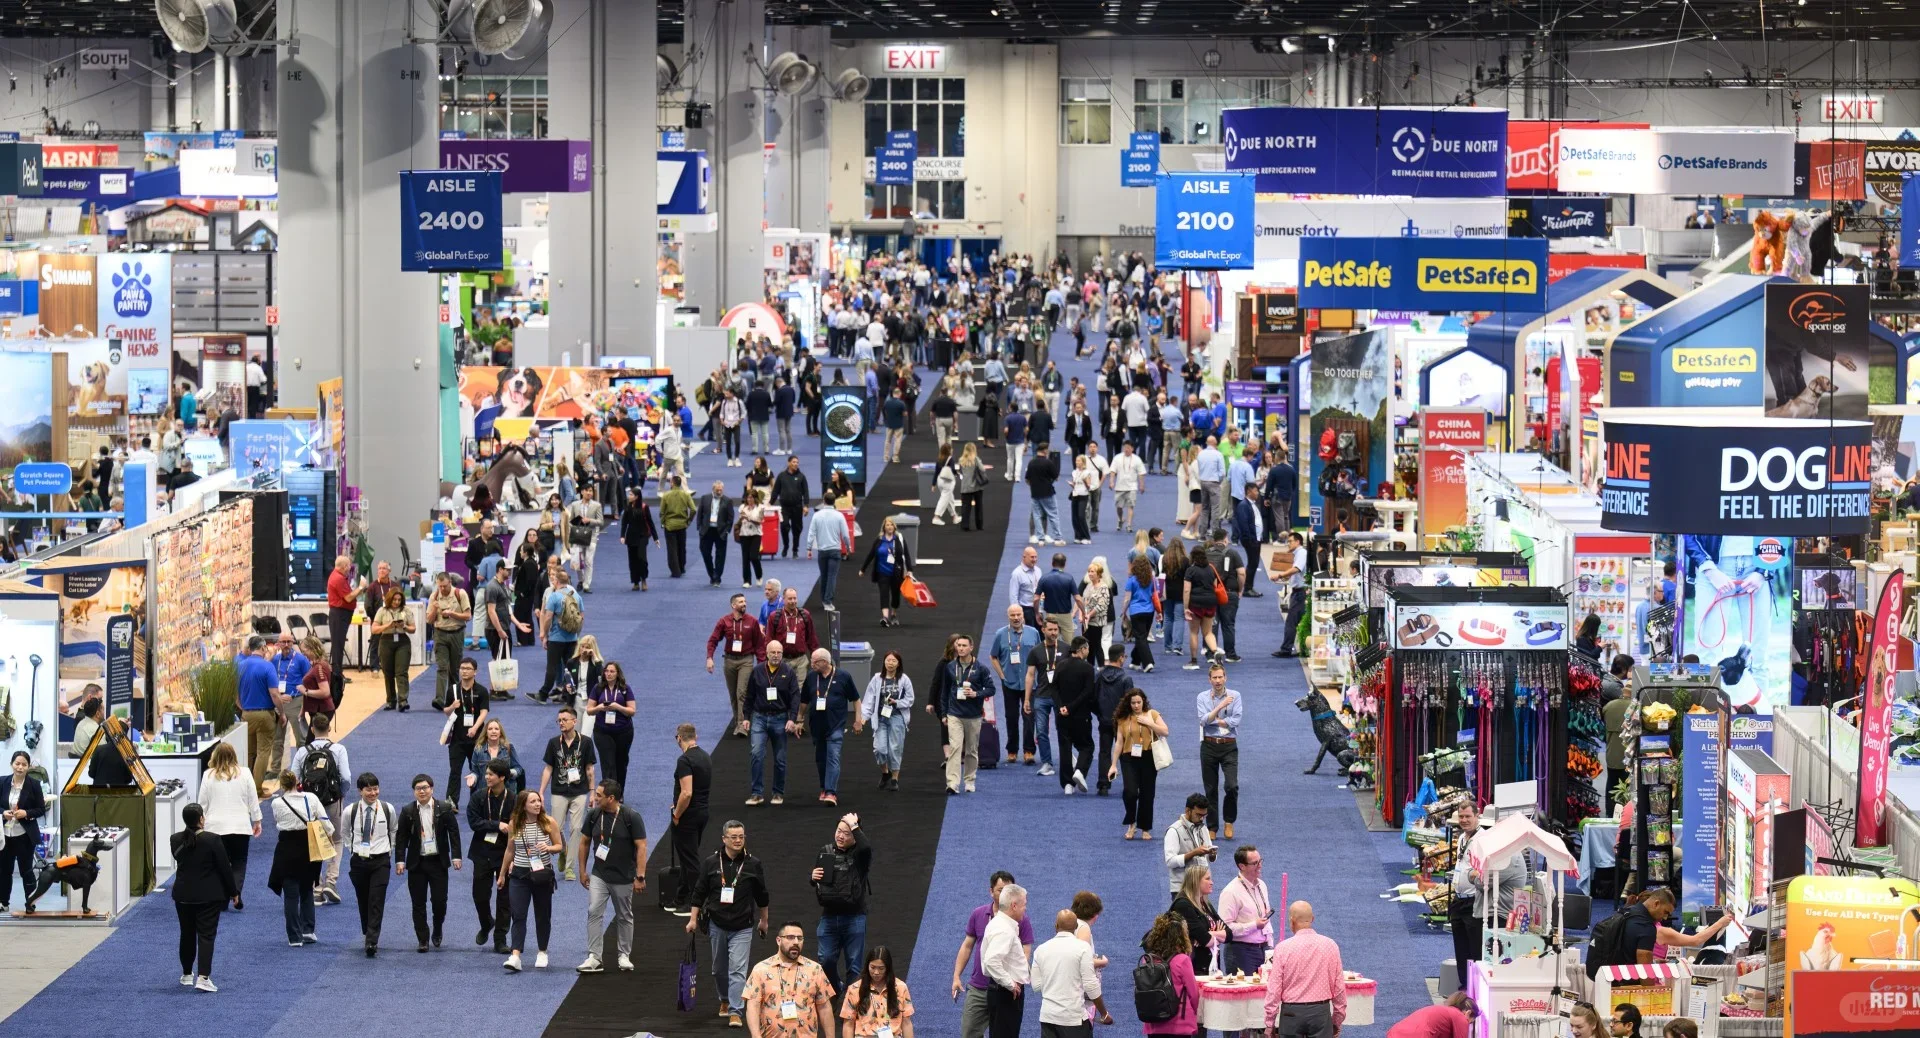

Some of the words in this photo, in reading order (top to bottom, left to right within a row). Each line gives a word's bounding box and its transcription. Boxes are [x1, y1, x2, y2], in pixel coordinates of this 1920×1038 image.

[82, 54, 128, 65] SOUTH
[888, 50, 940, 69] EXIT
[1826, 100, 1878, 119] EXIT
[1241, 137, 1261, 150] DUE
[1265, 136, 1317, 149] NORTH
[1432, 140, 1460, 152] DUE
[1464, 140, 1498, 152] NORTH
[882, 162, 908, 171] 2400
[1128, 164, 1152, 172] 2100
[1816, 157, 1860, 190] TERRITORY
[1392, 170, 1434, 178] REIMAGINE
[1436, 170, 1458, 178] RETAIL
[1460, 171, 1498, 179] REFRIGERATION
[426, 179, 476, 192] AISLE
[1182, 180, 1230, 194] AISLE
[418, 210, 484, 230] 2400
[1176, 211, 1234, 230] 2100
[1542, 210, 1595, 231] Triumph
[1304, 260, 1391, 288] PetSafe
[1425, 266, 1509, 285] PetSafe
[118, 300, 149, 312] PANTRY
[1268, 306, 1295, 316] EVOLVE
[1378, 311, 1400, 320] NEW
[1678, 354, 1736, 367] PetSafe
[1324, 367, 1336, 378] GO
[1336, 368, 1374, 380] TOGETHER
[1438, 420, 1472, 429] CHINA
[1429, 430, 1480, 440] PAVILION
[1720, 496, 1764, 519] FEEL
[1769, 495, 1802, 518] THE
[1869, 715, 1880, 734] Live
[1864, 732, 1881, 751] Demo
[1806, 908, 1822, 917] Use
[1824, 908, 1838, 918] for
[1841, 910, 1854, 918] All
[1856, 910, 1871, 920] Pet
[1872, 911, 1900, 922] Types
[1870, 992, 1908, 1008] RED
